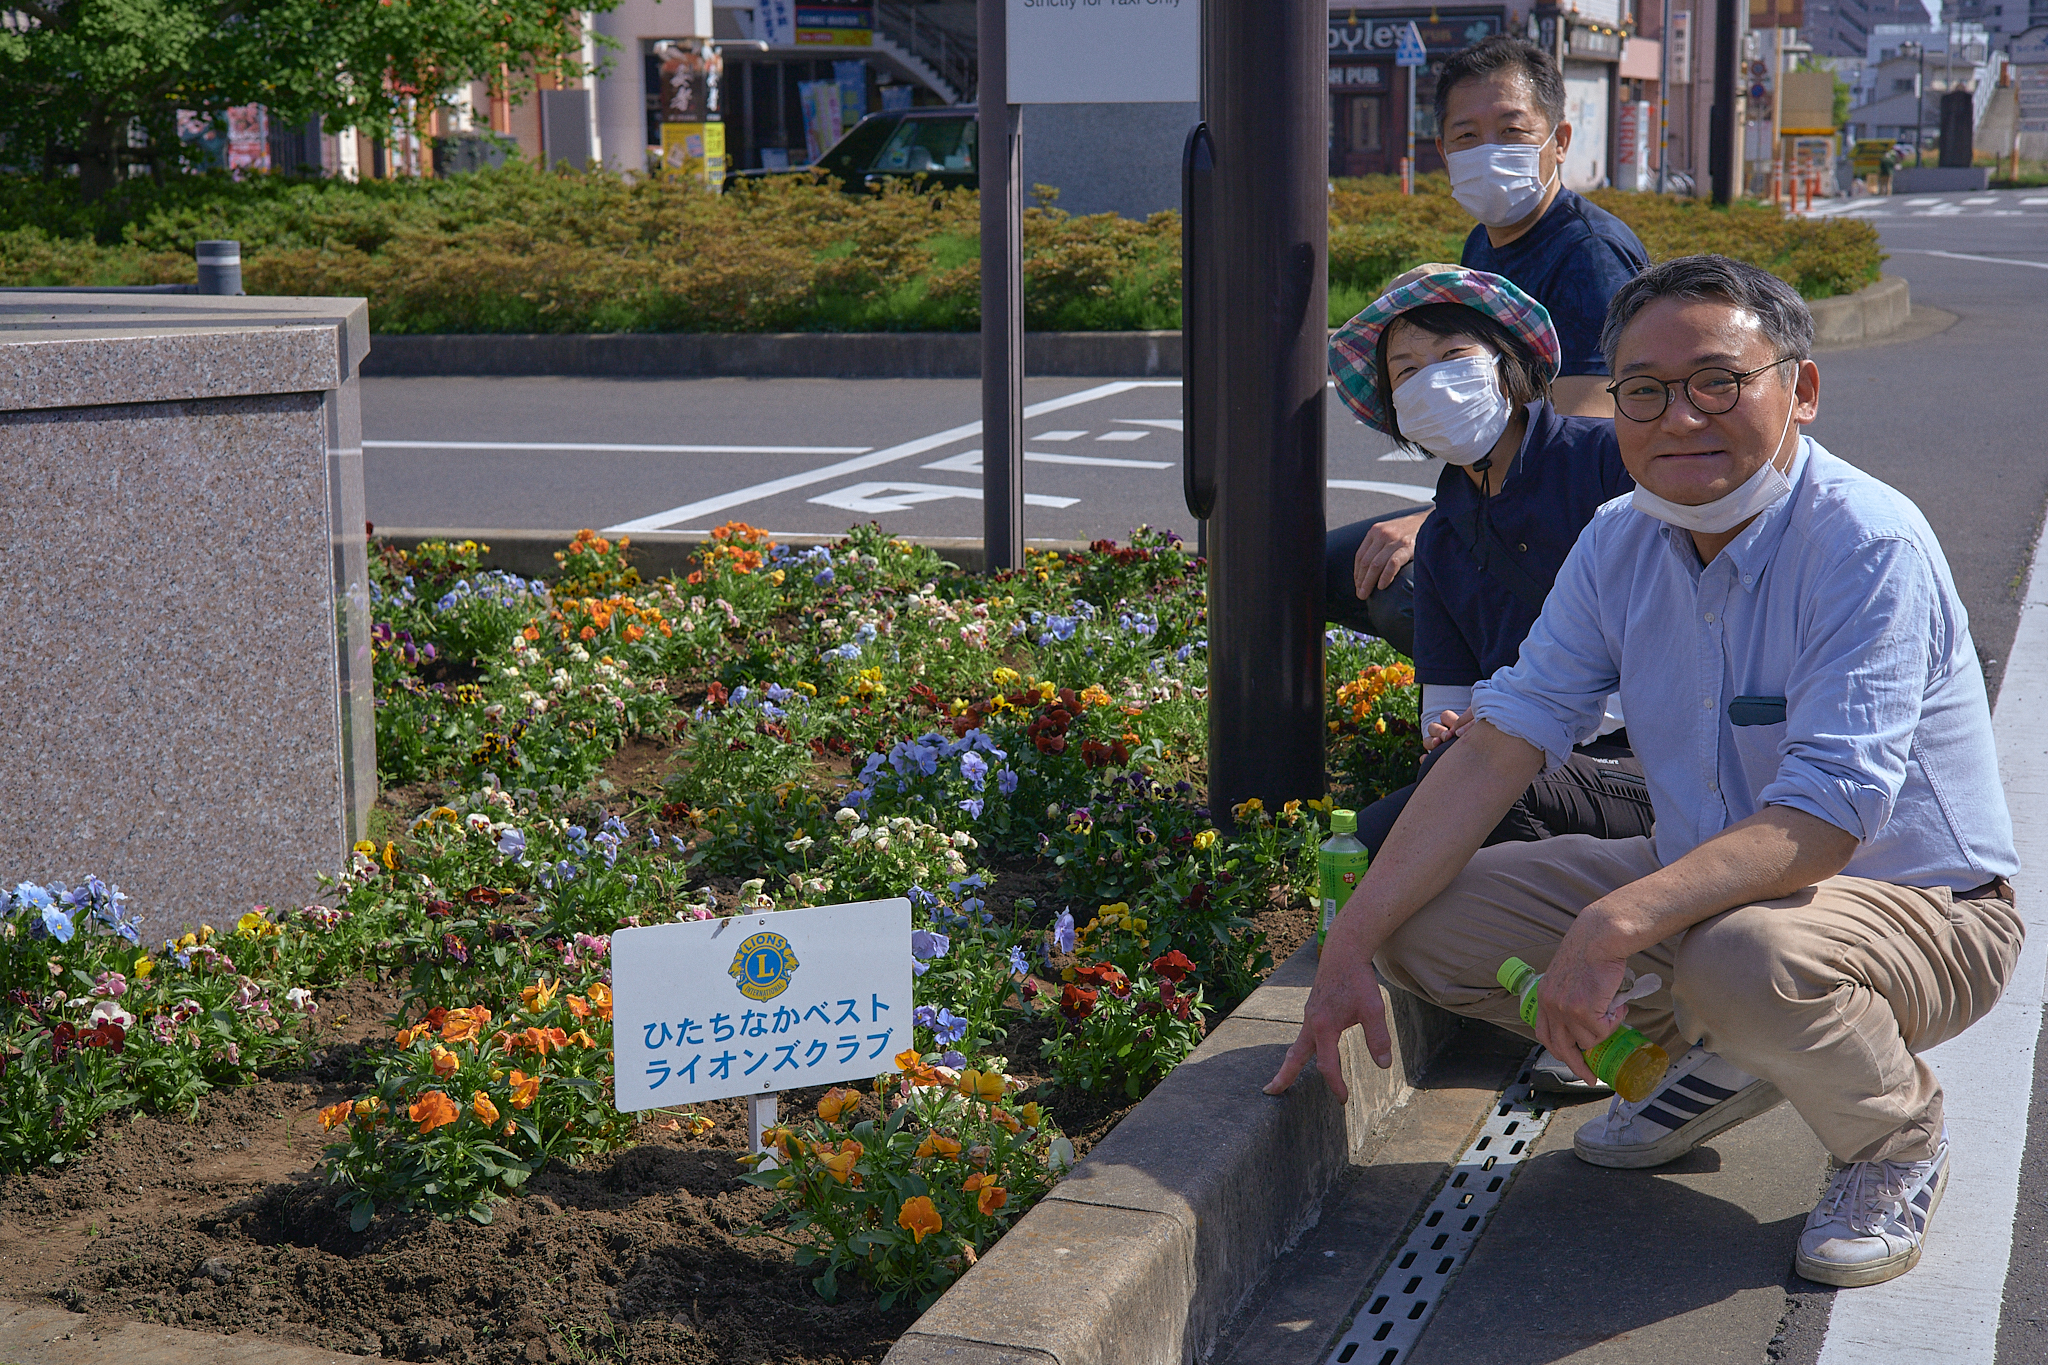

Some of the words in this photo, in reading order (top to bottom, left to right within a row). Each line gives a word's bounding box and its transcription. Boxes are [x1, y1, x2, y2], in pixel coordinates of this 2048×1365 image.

[1345, 66, 1380, 84] PUB
[1619, 106, 1637, 165] KIRIN
[743, 934, 785, 952] LIONS
[756, 954, 775, 978] L
[744, 982, 785, 997] INTERNATIONAL
[643, 993, 890, 1050] ひたちなかベスト
[645, 1027, 894, 1090] ライオンズクラブ
